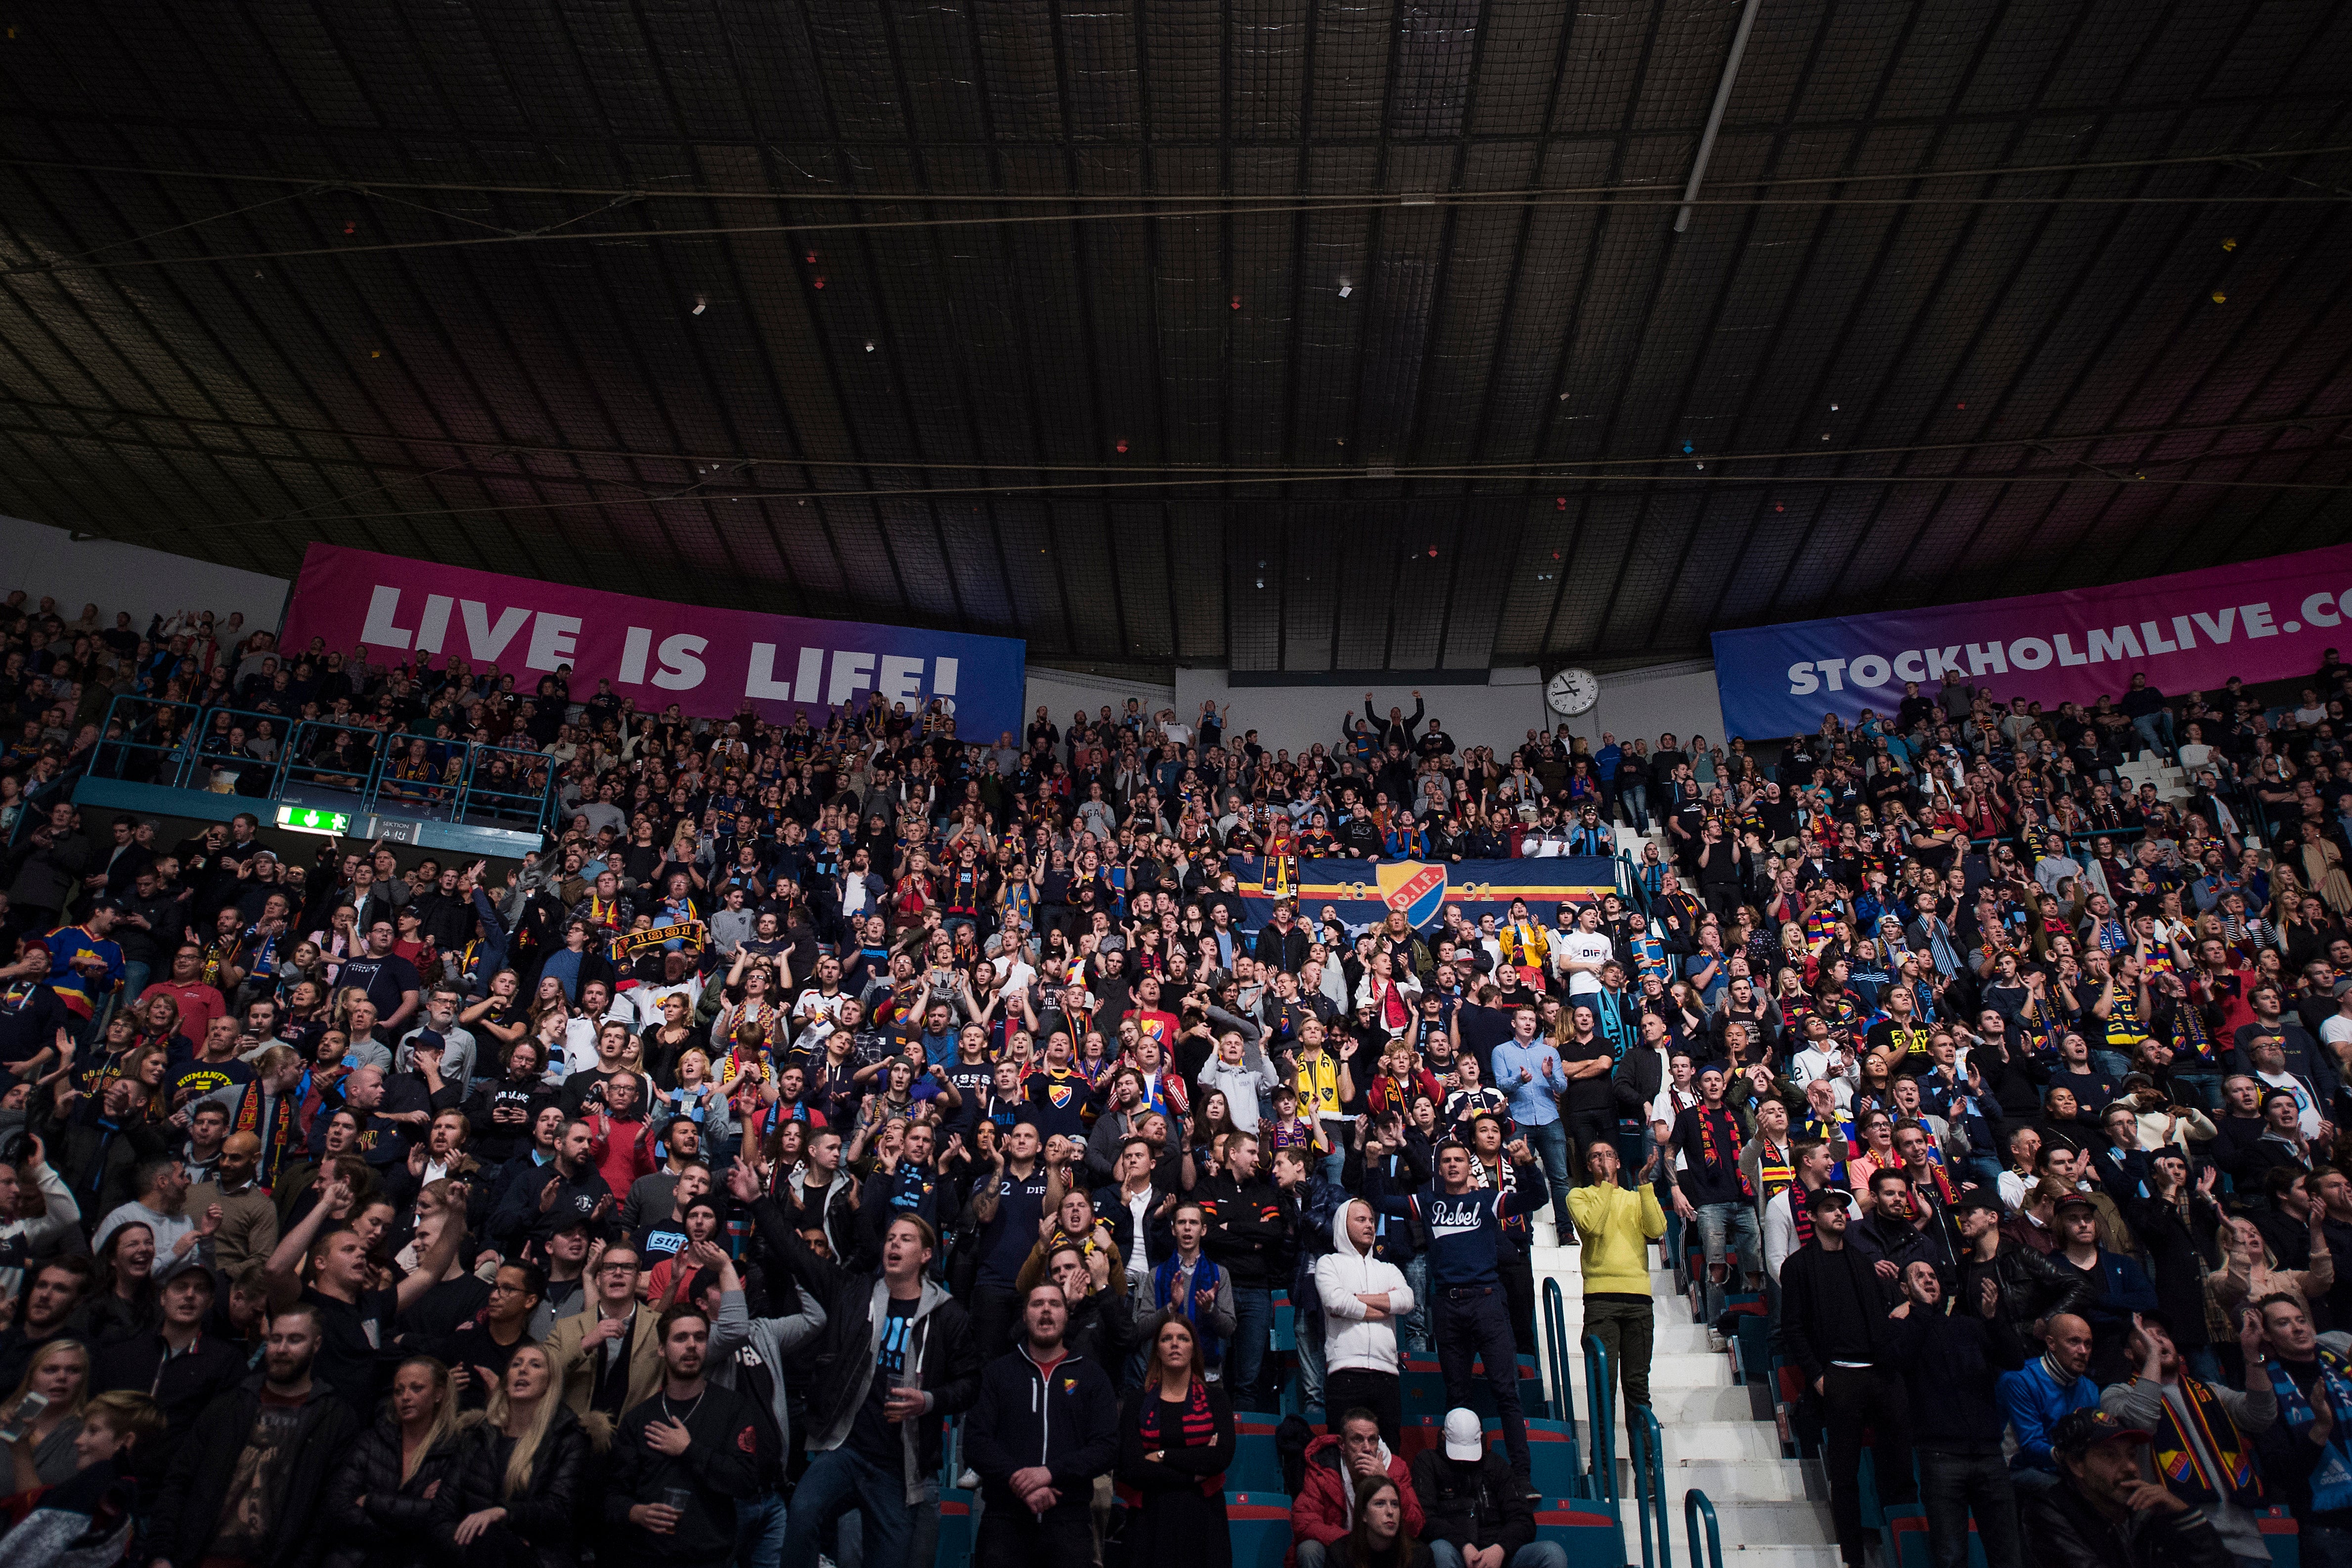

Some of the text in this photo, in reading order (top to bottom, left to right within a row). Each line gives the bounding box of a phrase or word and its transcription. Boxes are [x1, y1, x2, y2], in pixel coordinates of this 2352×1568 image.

[360, 584, 958, 715] LIVE IS LIFE!
[1337, 882, 1367, 900] 18
[1463, 882, 1494, 901] 91
[635, 925, 691, 943] 1891
[1893, 1036, 1929, 1051] PAY
[177, 1071, 233, 1087] HUMANITY
[1000, 1181, 1011, 1195] 2
[1026, 1186, 1047, 1195] DIF
[1432, 1200, 1481, 1227] Rebel
